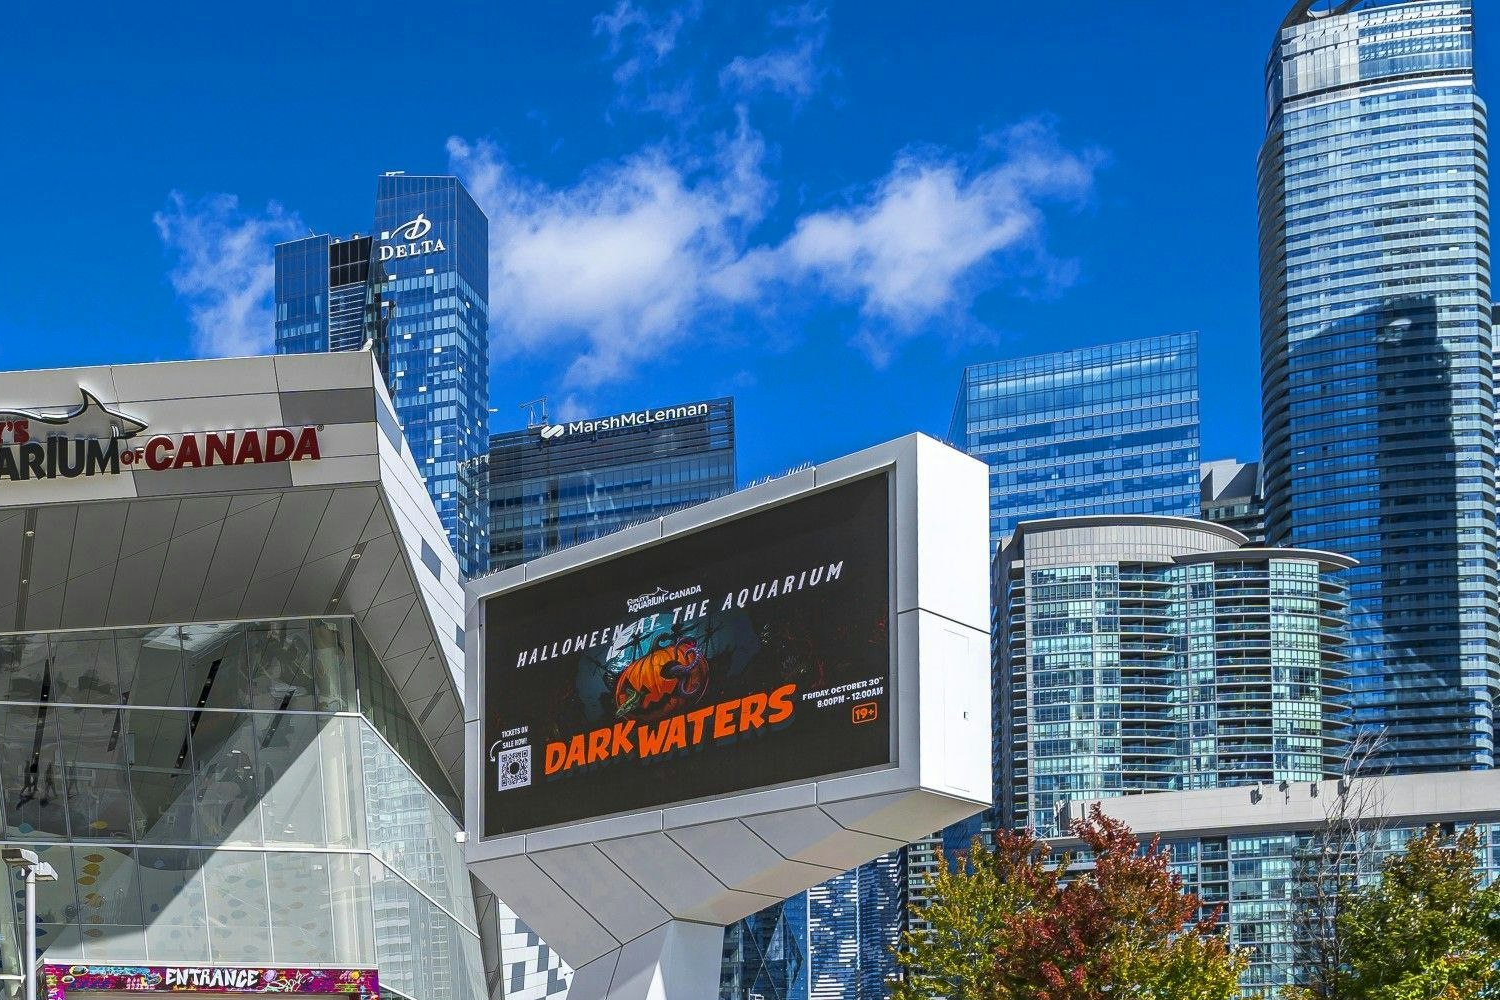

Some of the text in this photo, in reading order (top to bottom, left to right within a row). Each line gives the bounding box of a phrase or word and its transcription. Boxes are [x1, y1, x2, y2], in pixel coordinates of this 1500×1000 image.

[379, 238, 446, 261] DELTA
[569, 403, 708, 435] MarshMcLennan
[120, 447, 145, 466] OF
[669, 585, 701, 600] CANADA
[516, 560, 844, 668] HALLOWEEN AT THE AQUARIUM
[817, 695, 845, 707] 8:00PM
[852, 687, 884, 701] 12:00AM
[831, 681, 867, 694] OCTOBER
[502, 728, 520, 738] TICKETS
[545, 684, 798, 776] DARK WATERS
[165, 967, 259, 988] ENTRANCE
